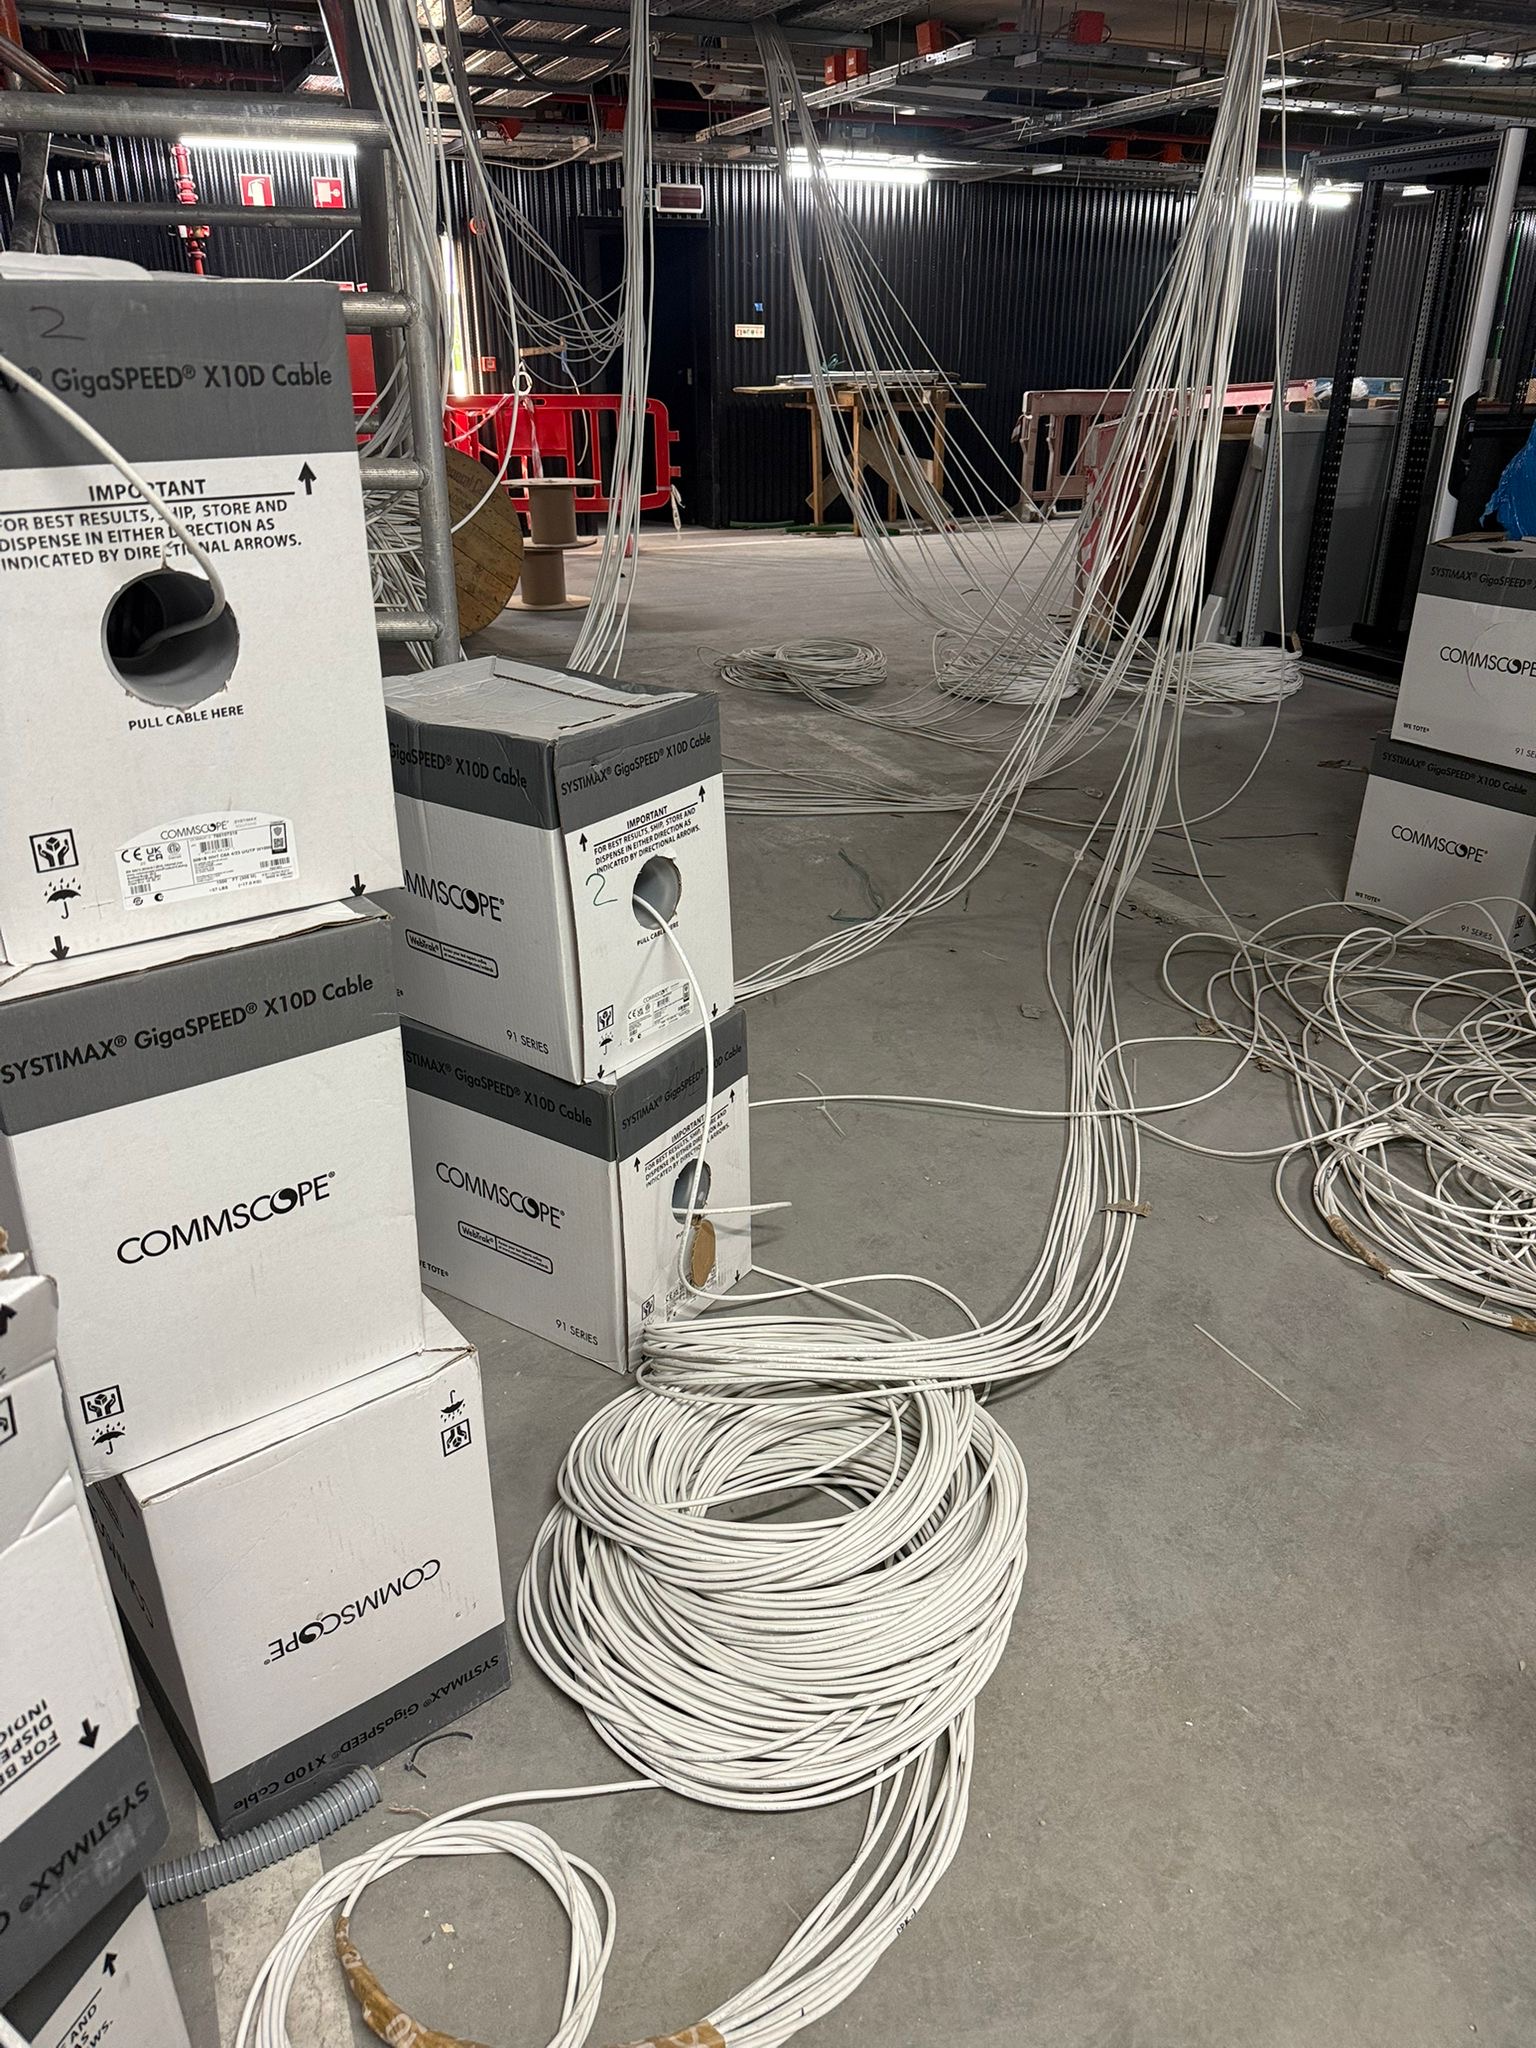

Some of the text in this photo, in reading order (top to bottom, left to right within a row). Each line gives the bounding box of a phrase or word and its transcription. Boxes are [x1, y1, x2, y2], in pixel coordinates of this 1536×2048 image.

[29, 305, 87, 342] 2
[204, 363, 265, 388] X10D
[272, 361, 333, 386] Cable
[88, 478, 207, 502] IMPOTANT
[33, 514, 75, 530] BEST
[80, 508, 155, 527] RESULTS,
[203, 501, 251, 517] STORE
[255, 499, 288, 513] AND
[86, 531, 104, 545] IN
[108, 526, 165, 544] EITHER
[168, 522, 251, 541] DRECTION
[256, 517, 276, 531] AS
[2, 553, 94, 571] INDICATED
[100, 549, 119, 563] BY
[234, 533, 302, 552] ARROWS.
[128, 704, 245, 731] PULL CABLE HERE
[666, 740, 688, 759] X10D
[689, 731, 712, 750] Cable
[455, 757, 489, 780] X10D
[492, 765, 528, 789] Cable
[1476, 774, 1501, 789] X10D
[1502, 781, 1528, 796] Cable
[594, 845, 608, 856] FOR
[607, 838, 623, 851] BEST
[683, 807, 696, 818] AND
[626, 805, 668, 830] IMPORTANT
[145, 846, 162, 855] UK
[147, 853, 164, 863] CA
[585, 872, 618, 907] 2
[1471, 927, 1494, 942] SERIES
[263, 986, 317, 1017] X10D
[321, 974, 375, 1002] Cable
[505, 1029, 550, 1055] 91 SERIES
[723, 1043, 742, 1062] Cable
[524, 1090, 556, 1113] X10D
[558, 1103, 593, 1127] Cable
[671, 1113, 705, 1144] IMPORTANT
[555, 1319, 599, 1347] 91 SERIES
[22, 1729, 60, 1761] FOR
[283, 1753, 328, 1786] X10D
[233, 1779, 280, 1811] Cable
[70, 2003, 98, 2044] AND
